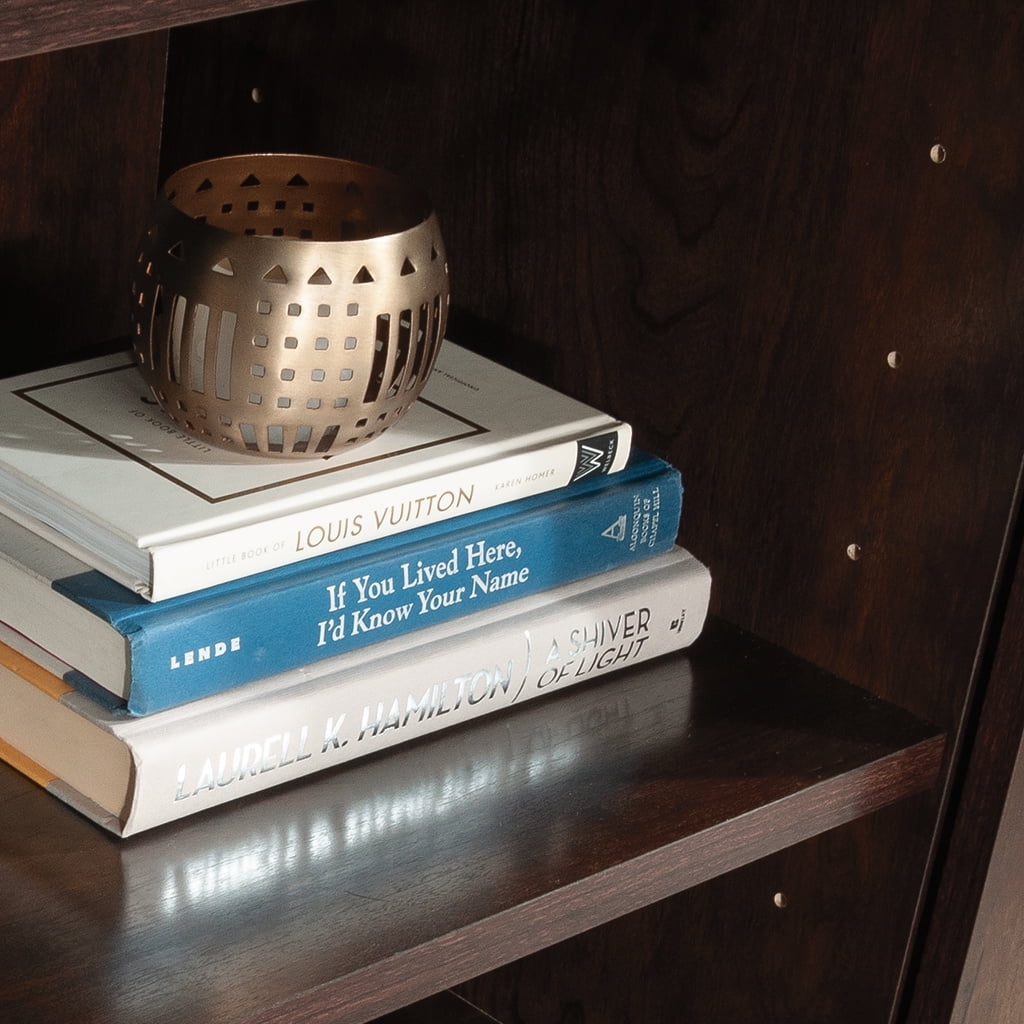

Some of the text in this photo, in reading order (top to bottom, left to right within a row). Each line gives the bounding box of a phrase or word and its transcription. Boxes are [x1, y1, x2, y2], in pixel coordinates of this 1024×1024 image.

[146, 416, 177, 435] BOOK
[175, 433, 212, 454] LITTLE
[601, 439, 615, 473] WELBECK
[494, 468, 556, 490] KAREN HOMER
[652, 486, 660, 511] HILL
[295, 483, 475, 552] LOUIS VUITTON
[629, 494, 642, 552] ALGONQUIN
[639, 512, 651, 544] BOOKS
[240, 545, 268, 561] BOOK
[326, 539, 523, 613] If You Lived Here,
[316, 566, 530, 647] I'd Know Your Name
[545, 637, 562, 665] A
[570, 606, 651, 654] SHIVER
[169, 636, 242, 670] LENDE
[536, 635, 650, 689] OF LIGHT
[173, 659, 513, 802] LAURELL K. HAMILTON
